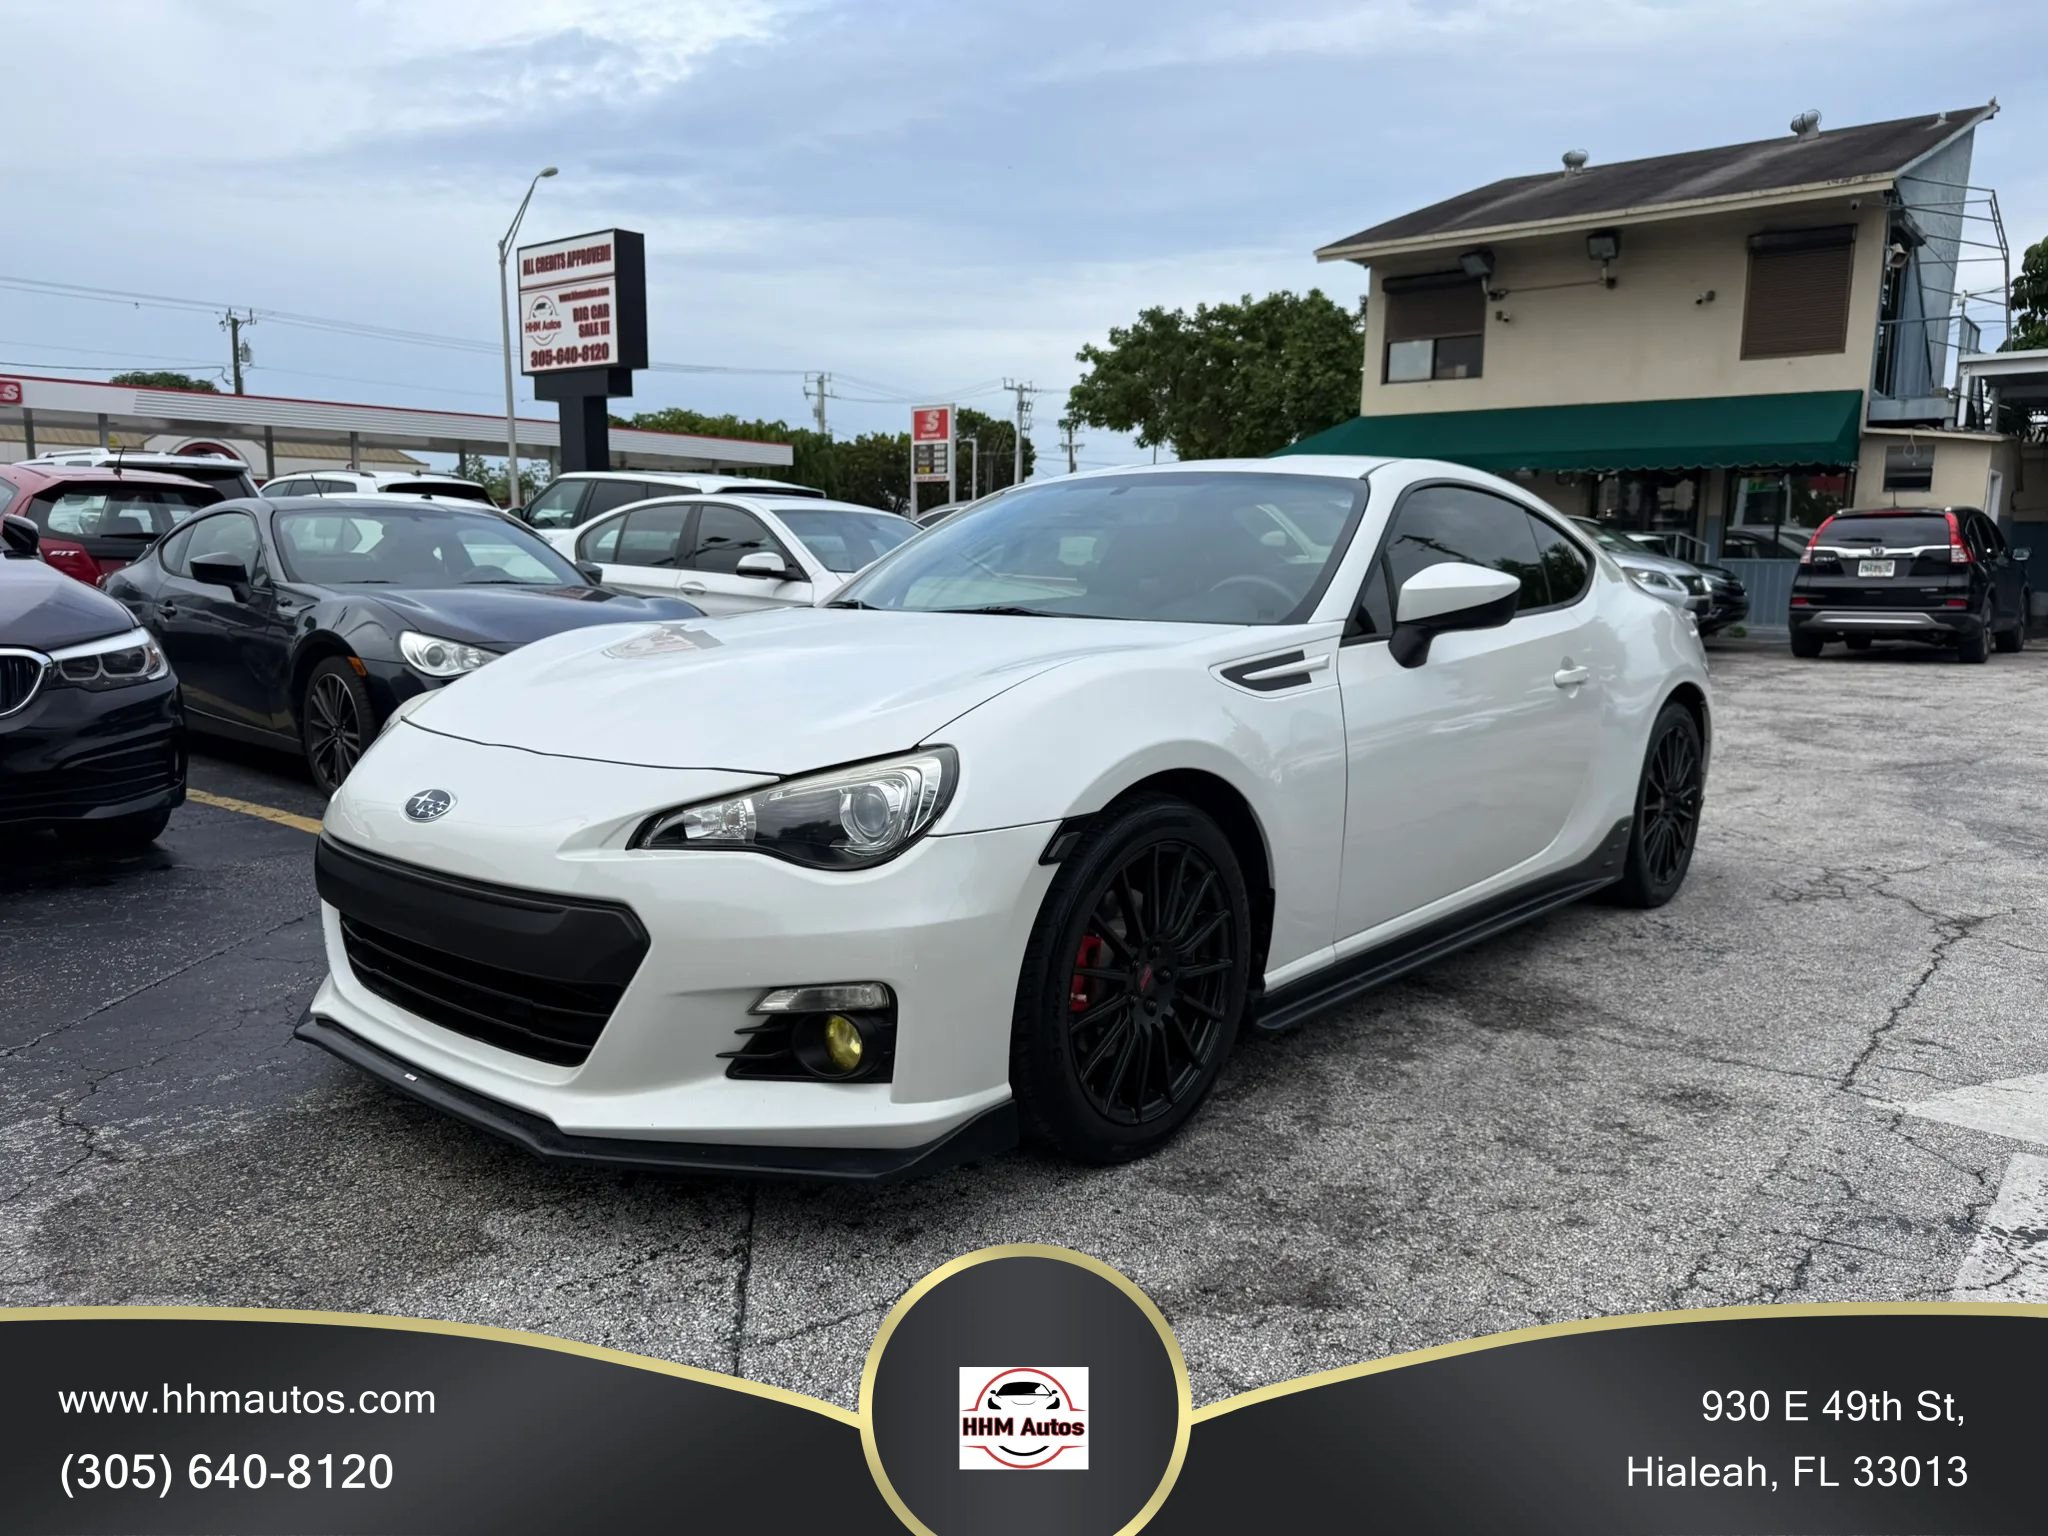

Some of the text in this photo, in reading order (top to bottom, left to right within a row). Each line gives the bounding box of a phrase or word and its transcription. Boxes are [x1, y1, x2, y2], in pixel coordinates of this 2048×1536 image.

[523, 258, 535, 276] ALL
[535, 252, 566, 274] CREDITS
[572, 303, 610, 323] BIG CAR
[578, 322, 599, 338] SALE
[530, 342, 610, 368] 305-640-8120
